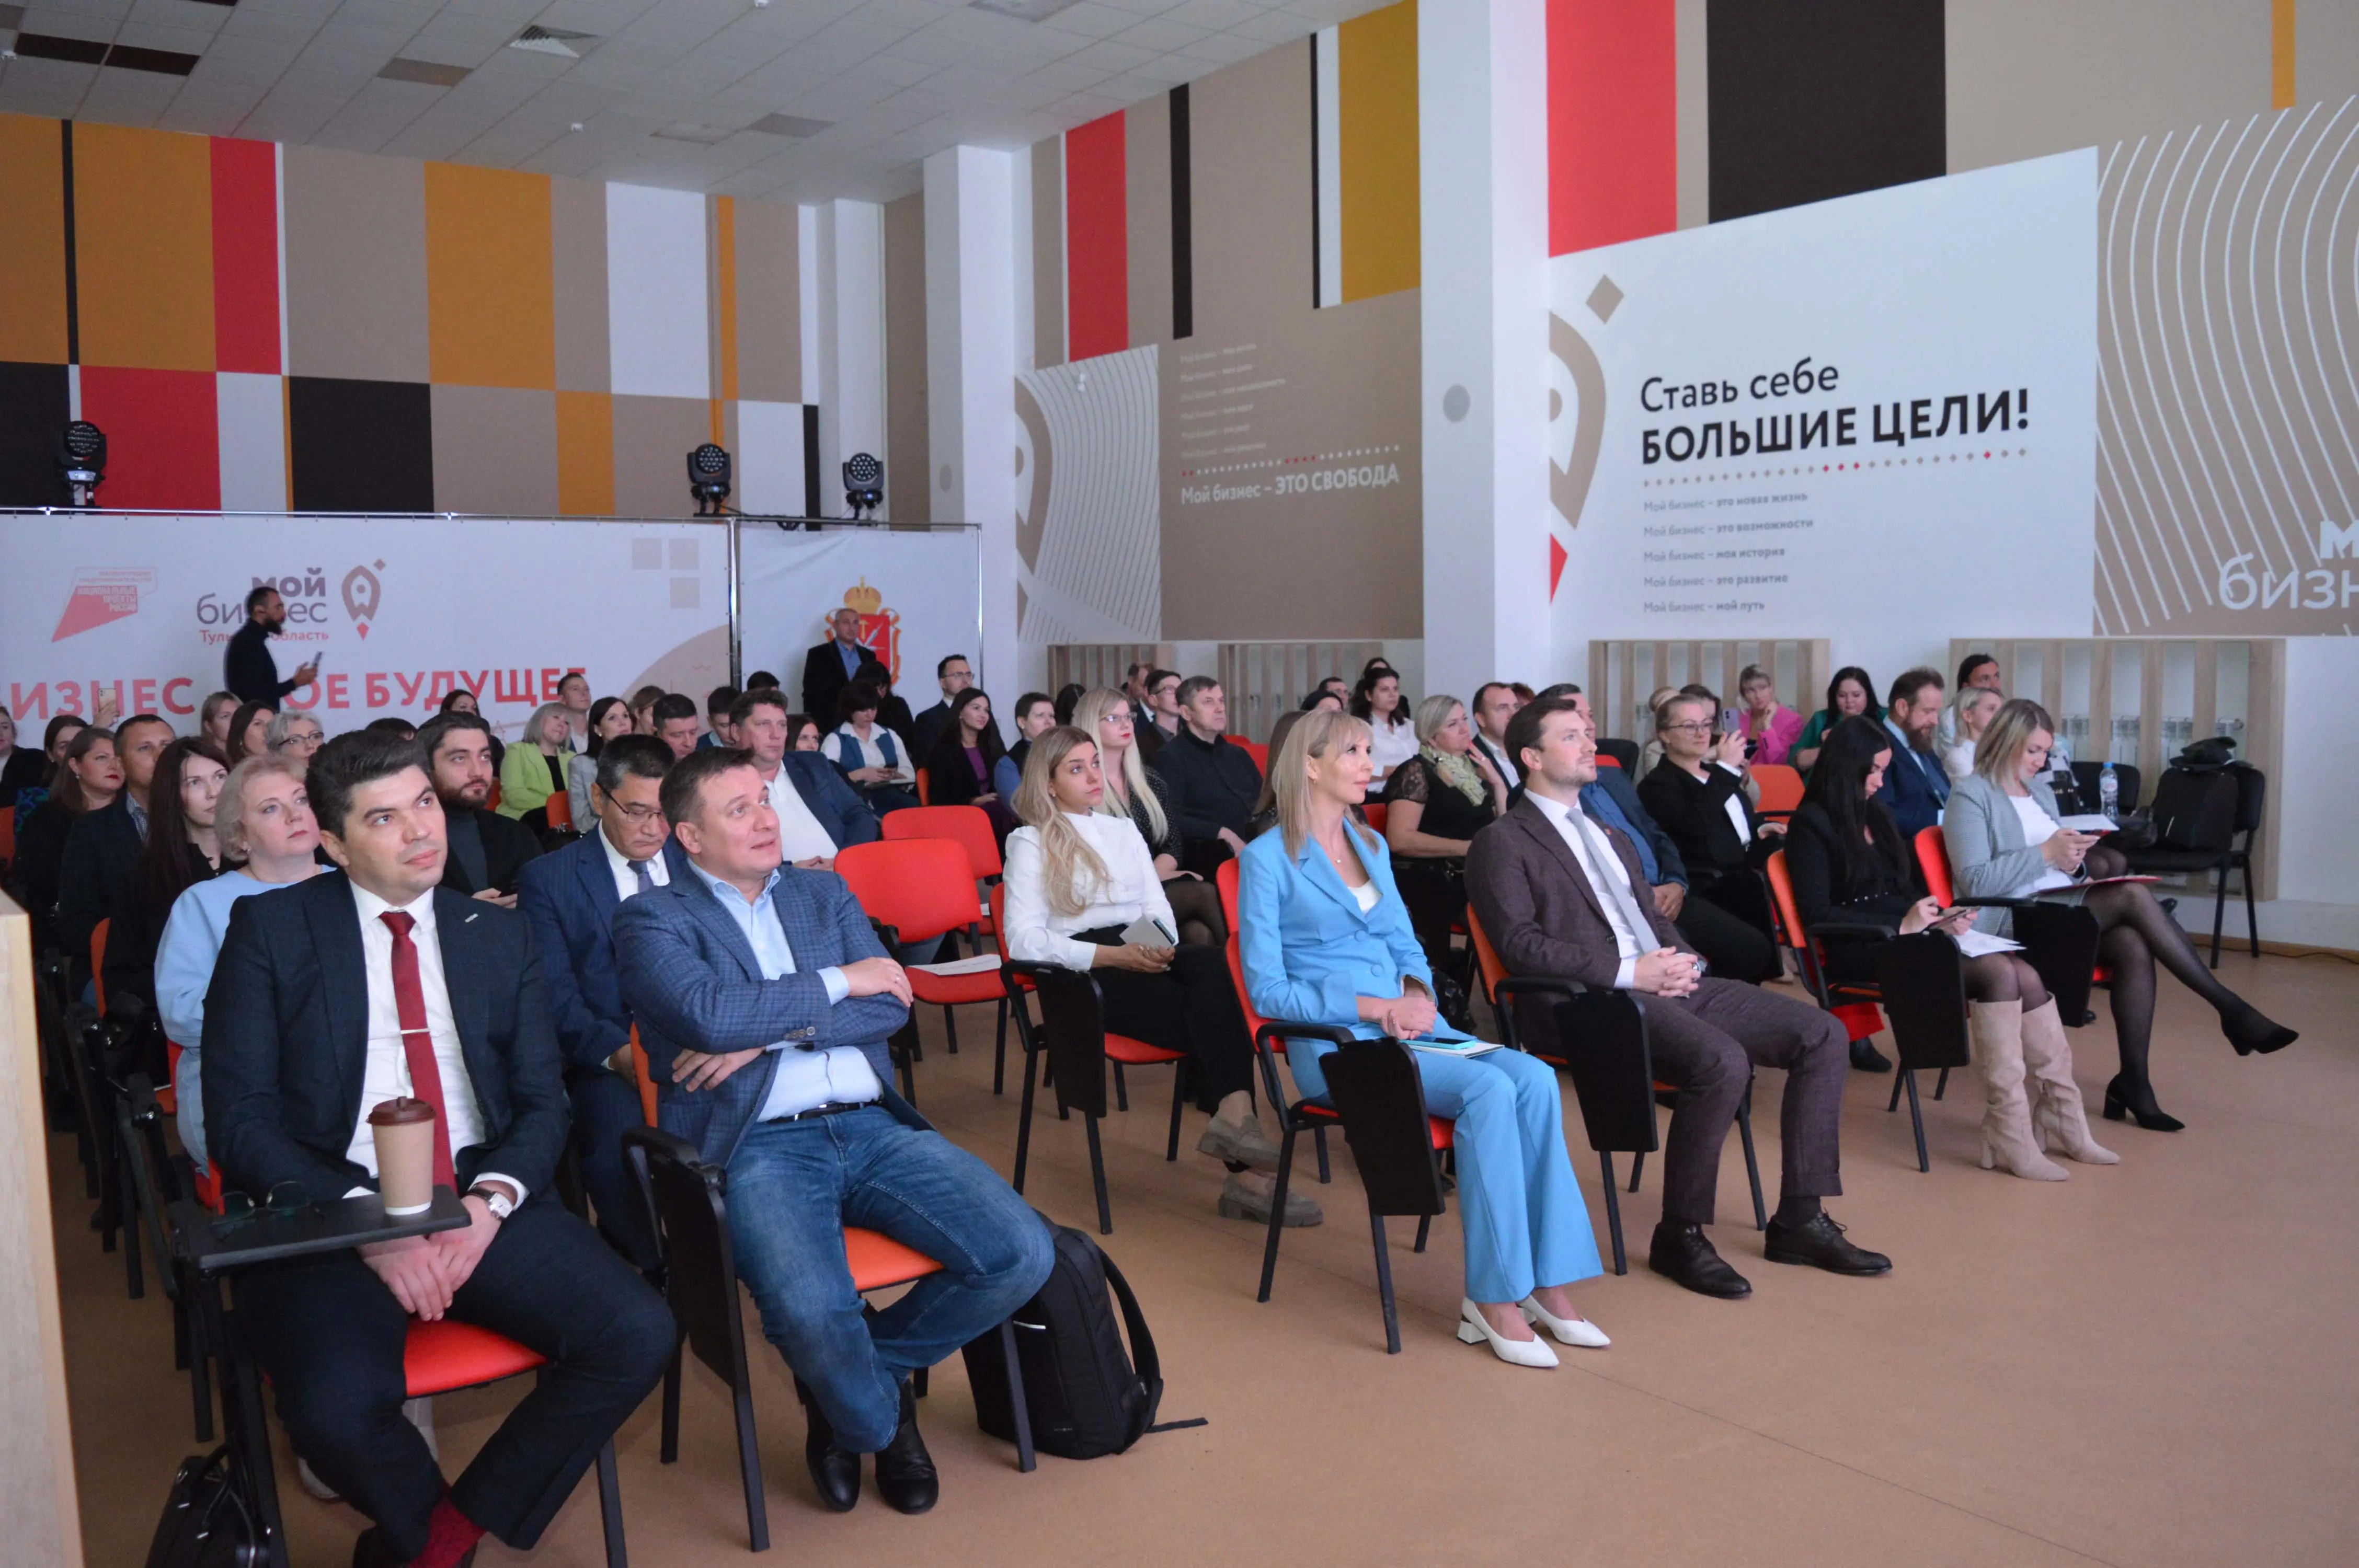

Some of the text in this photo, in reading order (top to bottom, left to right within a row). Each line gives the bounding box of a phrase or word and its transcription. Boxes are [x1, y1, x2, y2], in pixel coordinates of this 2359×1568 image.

[1641, 355, 1839, 412] Ставь себе
[1642, 388, 2029, 465] БОЛЬШИЕ ЦЕЛИ!
[1182, 486, 1210, 504] Мой
[1213, 483, 1261, 502] бизнес
[1275, 473, 1308, 495] ЭТО
[1311, 463, 1400, 491] СВОБОДА
[1643, 501, 1666, 512] Мой
[1668, 499, 1705, 511] бизнес
[1716, 498, 1734, 508] это
[1737, 495, 1769, 505] новая
[1771, 493, 1808, 503] жизнь
[1643, 526, 1666, 537] Мой
[1668, 525, 1705, 536] бизнес
[1716, 524, 1734, 533] это
[1737, 520, 1814, 532] возможности
[1643, 551, 1666, 562] Мой
[1668, 550, 1705, 561] бизнес
[1739, 548, 1785, 559] история
[1643, 577, 1666, 588] Мой
[1668, 575, 1705, 586] бизнес
[1716, 575, 1734, 584] это
[197, 592, 328, 624] биес
[1643, 602, 1666, 613] Мой
[1668, 601, 1705, 612] бизнес
[1716, 599, 1737, 610] мой
[1740, 601, 1765, 613] путь
[365, 667, 586, 711] БУДУЩЕ
